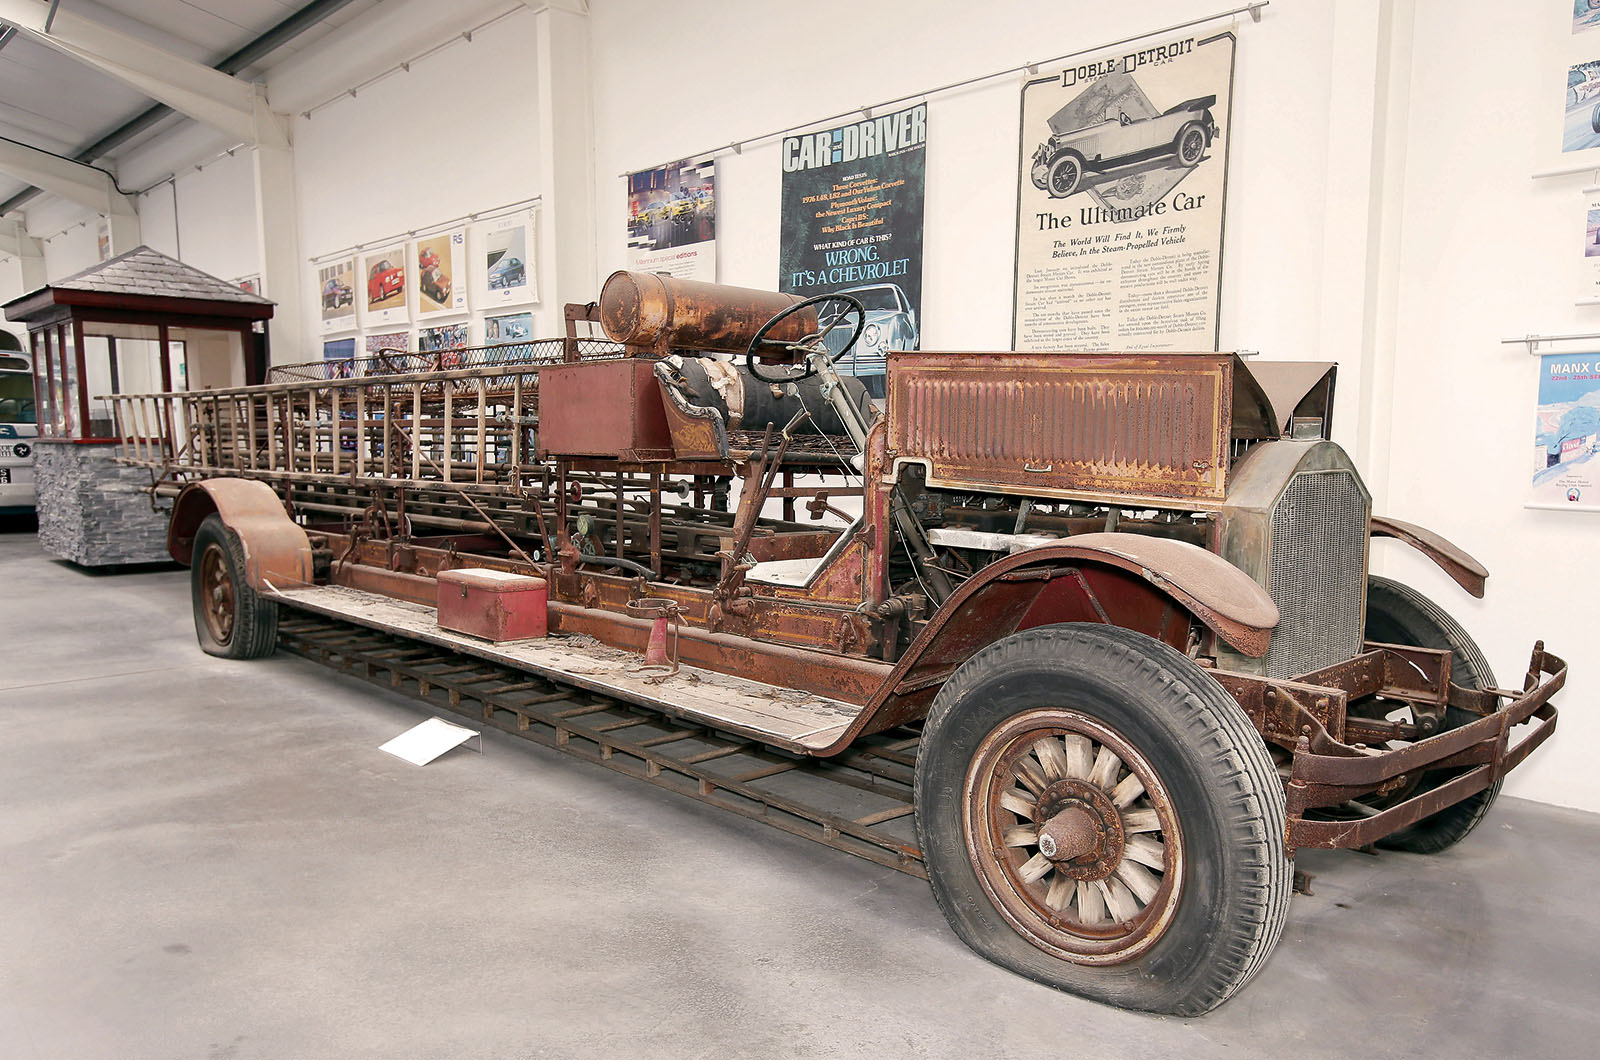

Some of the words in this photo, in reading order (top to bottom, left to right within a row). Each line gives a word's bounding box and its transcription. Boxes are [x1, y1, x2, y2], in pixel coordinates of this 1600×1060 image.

[1154, 58, 1173, 67] CAR
[783, 131, 832, 173] CAR
[842, 104, 926, 163] DRIVER
[815, 210, 825, 218] the
[825, 208, 846, 218] Newest
[846, 204, 866, 216] Luxury
[866, 199, 892, 212] Compact
[1036, 212, 1072, 231] The
[1080, 200, 1167, 227] Ultimate
[1172, 191, 1206, 212] Car
[821, 226, 835, 234] Why
[835, 222, 851, 232] Black
[857, 217, 884, 229] Beautiful
[841, 214, 858, 225] Capri
[452, 233, 464, 245] RS
[813, 242, 832, 251] WHAT
[831, 240, 847, 249] KIND
[847, 239, 856, 247] OF
[856, 237, 869, 246] CAR
[869, 236, 876, 244] IS
[875, 232, 892, 243] THIS?
[1052, 240, 1067, 249] The
[1070, 237, 1092, 247] World
[1095, 234, 1111, 244] Will
[1114, 231, 1131, 241] Find
[1135, 230, 1144, 240] It,
[1147, 228, 1159, 238] We
[1162, 224, 1187, 236] Firmly
[675, 250, 698, 260] editions
[824, 245, 880, 267] WRONG.
[1052, 248, 1078, 259] Believe,
[1079, 246, 1088, 256] In
[1089, 246, 1101, 255] the
[1101, 238, 1160, 254] Steam-Propelled
[1161, 235, 1186, 246] Vehicle
[791, 269, 815, 288] IT'S
[816, 270, 828, 283] A
[829, 258, 910, 284] CHEVROLET
[1550, 362, 1590, 375] MANX
